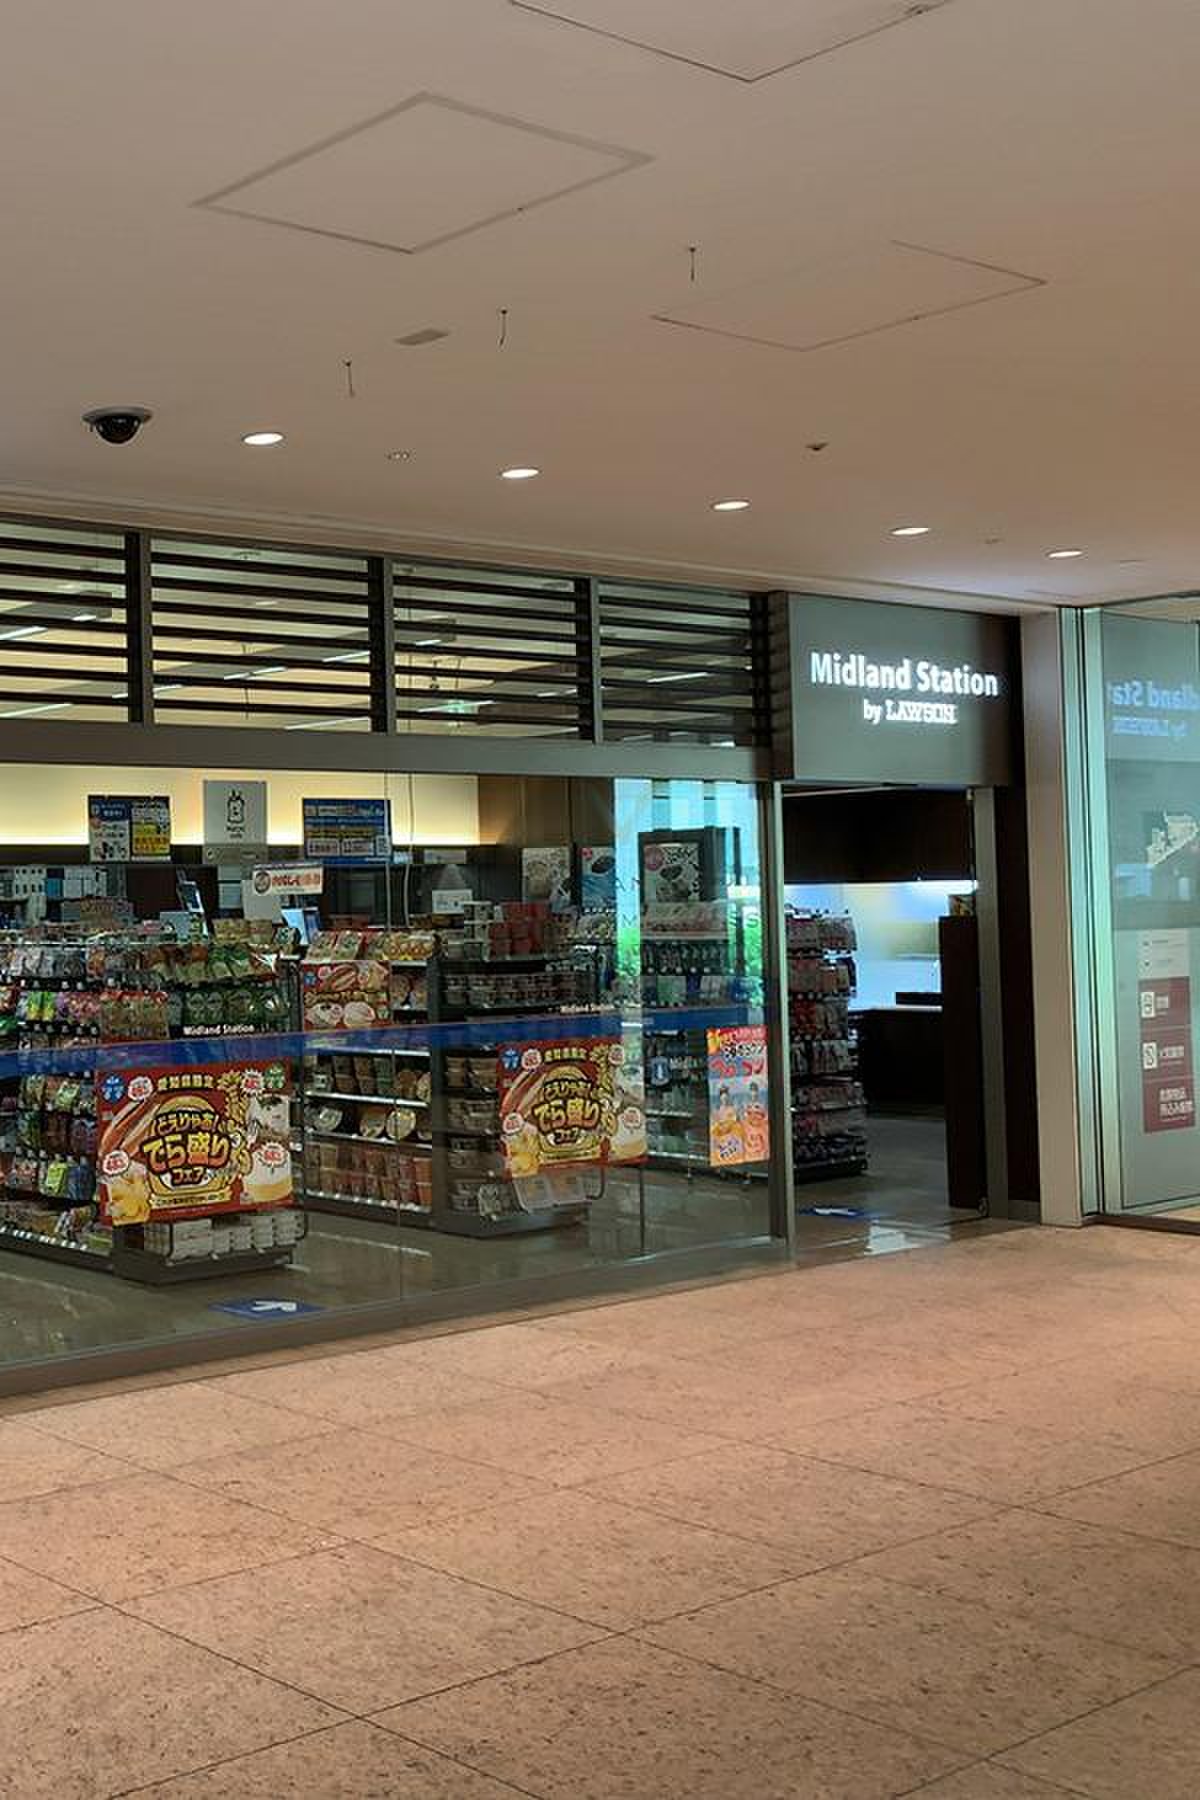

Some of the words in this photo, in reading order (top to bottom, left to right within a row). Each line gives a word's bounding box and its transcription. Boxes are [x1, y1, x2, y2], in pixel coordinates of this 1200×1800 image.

[811, 653, 912, 690] Midland
[917, 661, 998, 696] Station
[864, 699, 881, 724] by
[885, 700, 957, 724] LAWSON
[143, 1132, 231, 1172] でら盛り
